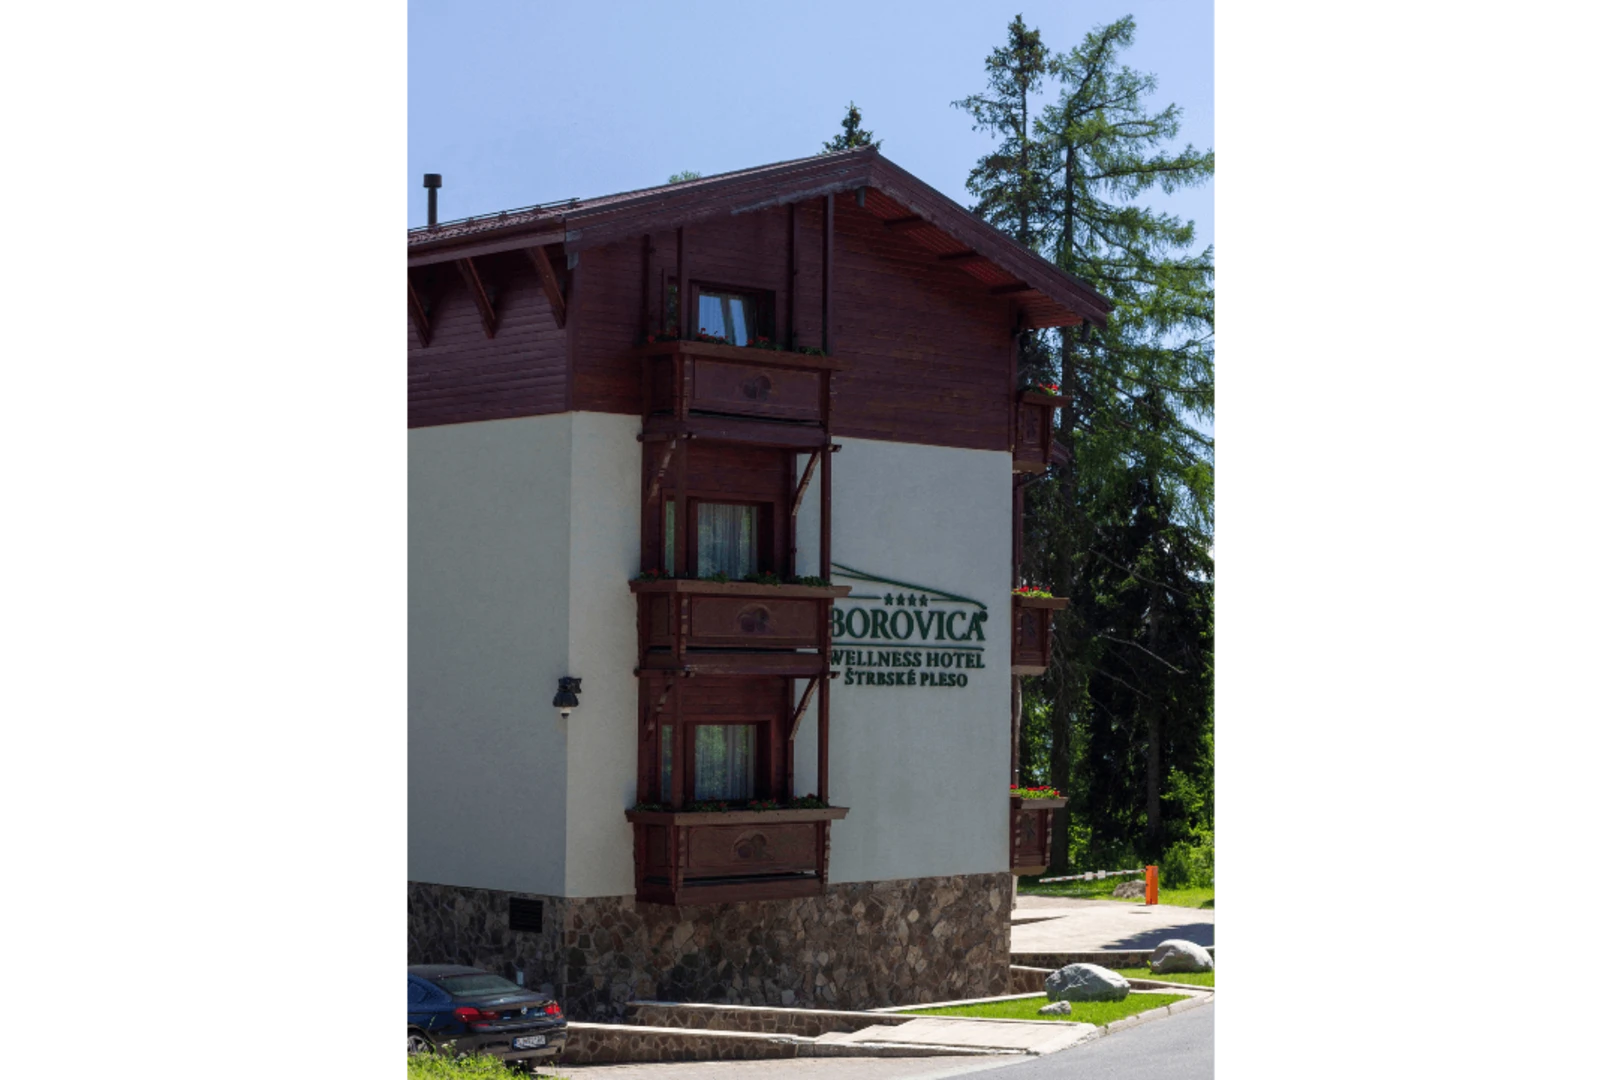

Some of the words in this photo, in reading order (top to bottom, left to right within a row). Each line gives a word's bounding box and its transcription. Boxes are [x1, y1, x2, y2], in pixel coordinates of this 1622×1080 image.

[831, 607, 987, 641] BOROVICA
[830, 650, 922, 668] WELLNESS
[926, 651, 986, 669] HOTEL
[844, 667, 917, 686] ŠTRBSKÉ
[919, 672, 968, 688] PLESO
